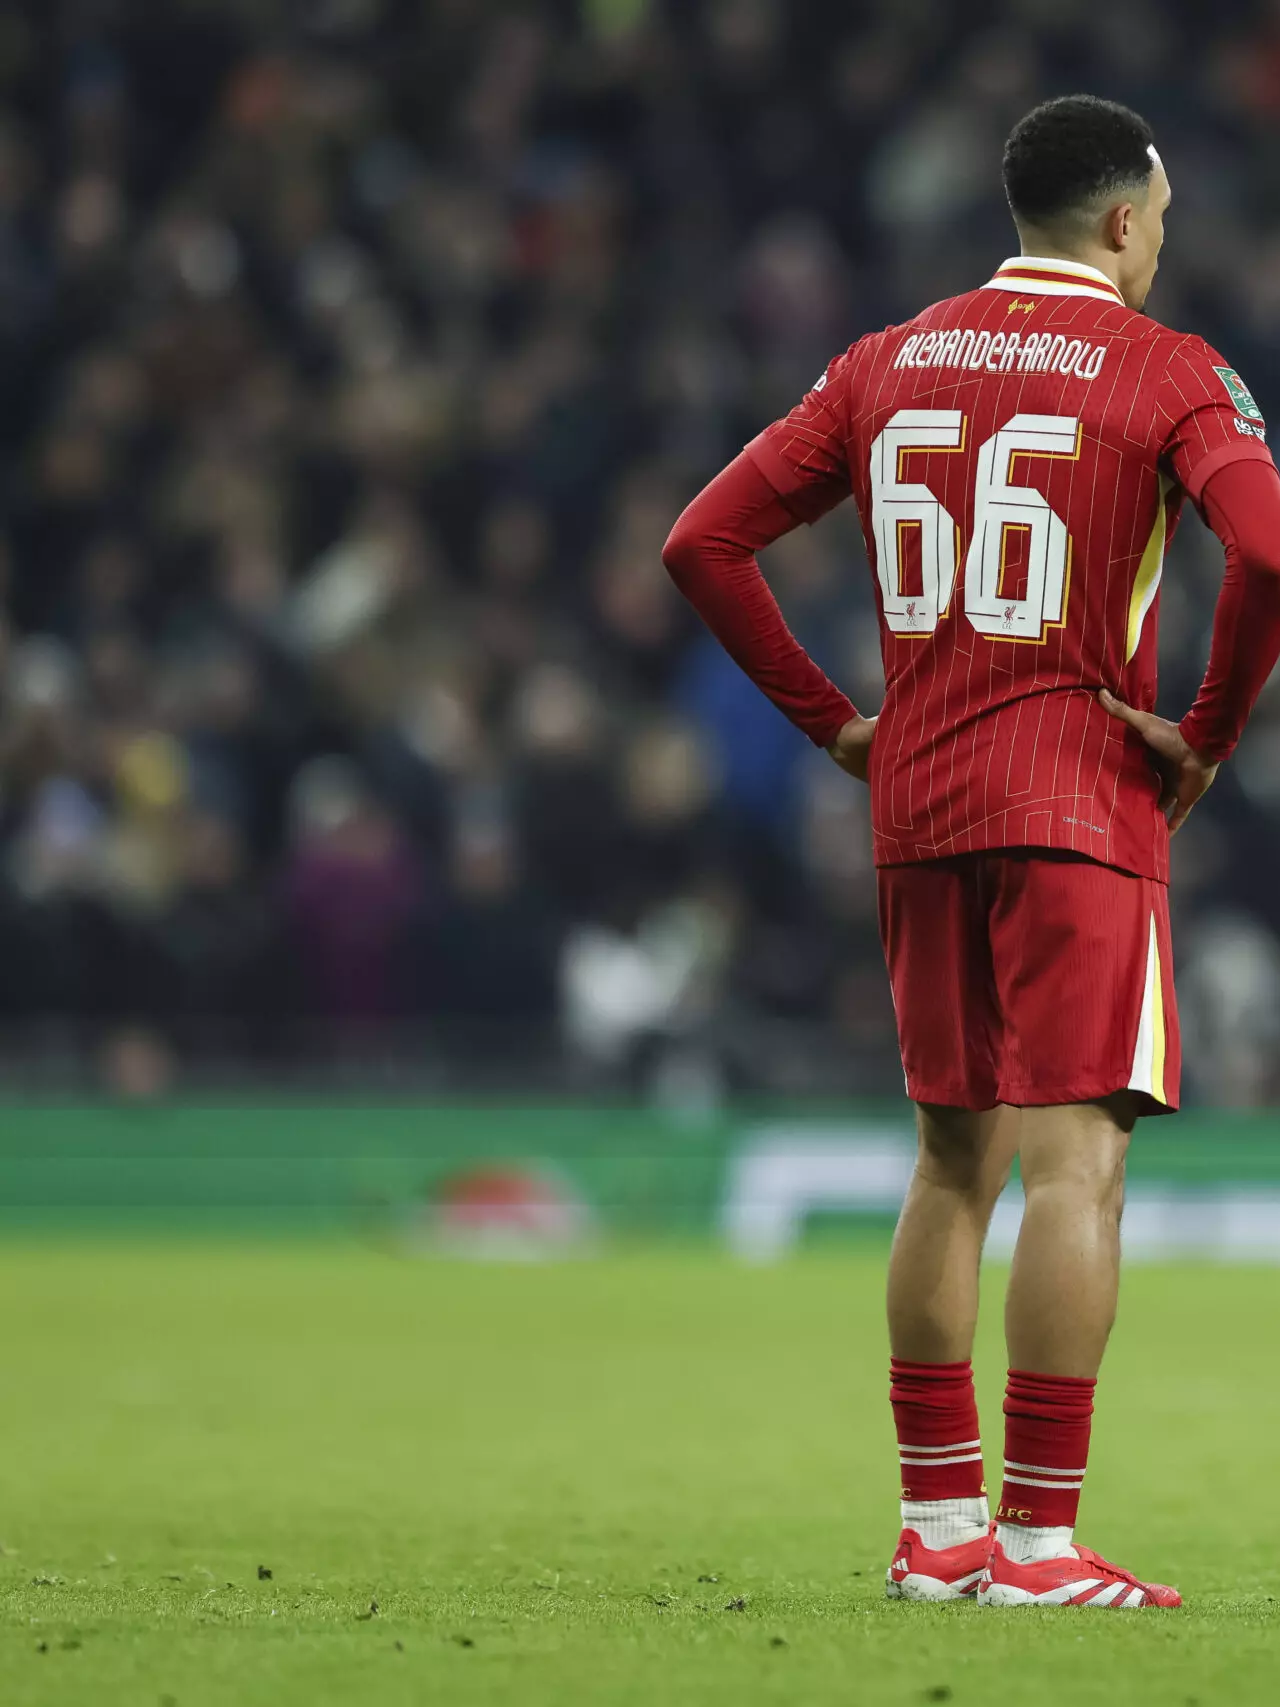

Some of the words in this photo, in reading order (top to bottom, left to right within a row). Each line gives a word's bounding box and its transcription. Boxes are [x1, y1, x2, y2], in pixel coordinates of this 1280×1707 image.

[893, 328, 1108, 380] ALEXANDER-ARNOLD
[870, 409, 1083, 645] 66
[997, 1505, 1032, 1520] LFC
